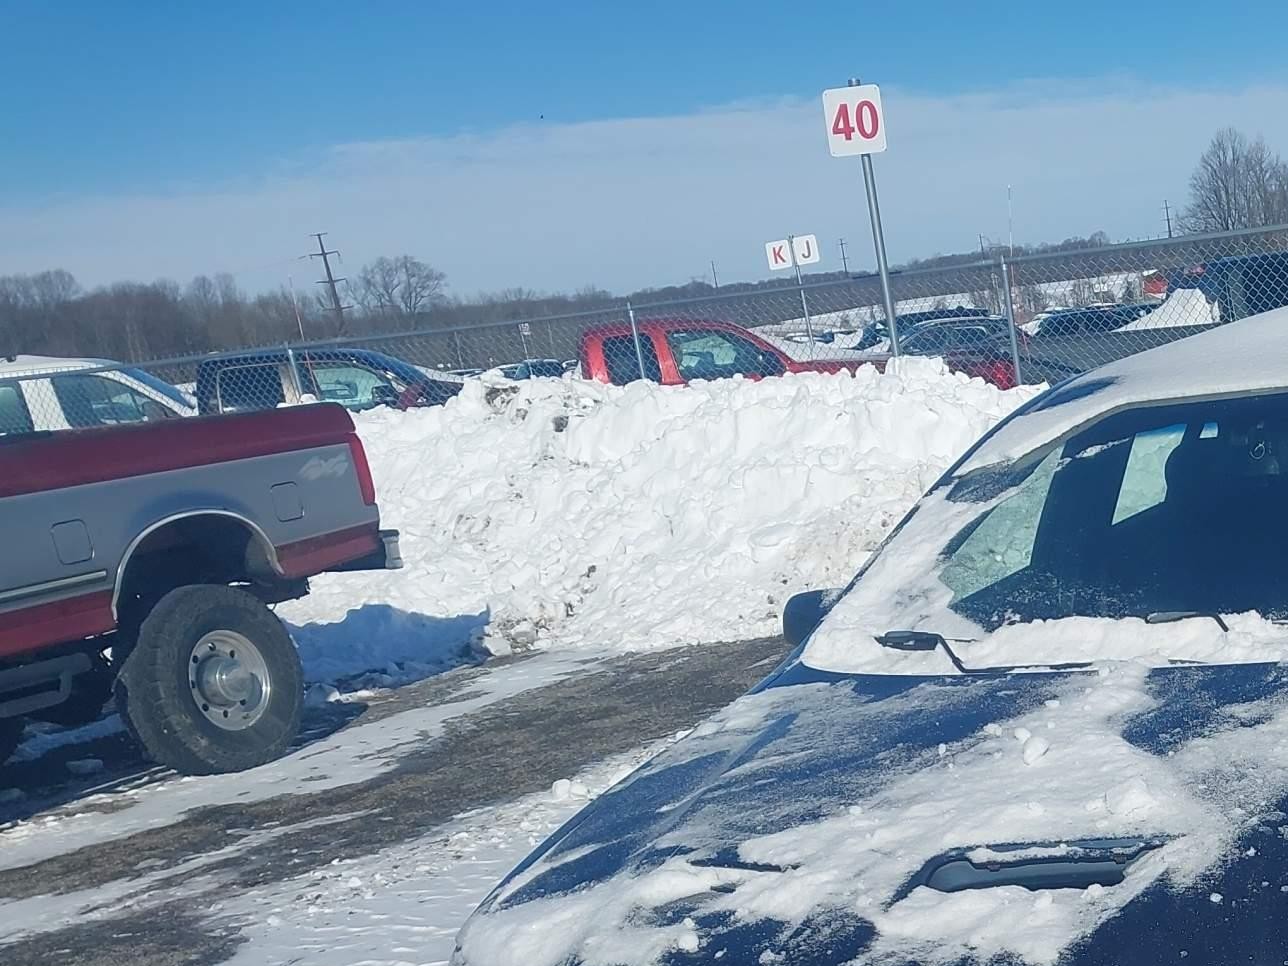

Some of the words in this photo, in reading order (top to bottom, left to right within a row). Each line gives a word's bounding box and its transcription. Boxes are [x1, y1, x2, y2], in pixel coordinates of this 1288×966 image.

[832, 100, 879, 141] 40
[772, 245, 786, 265] K
[802, 240, 812, 259] J
